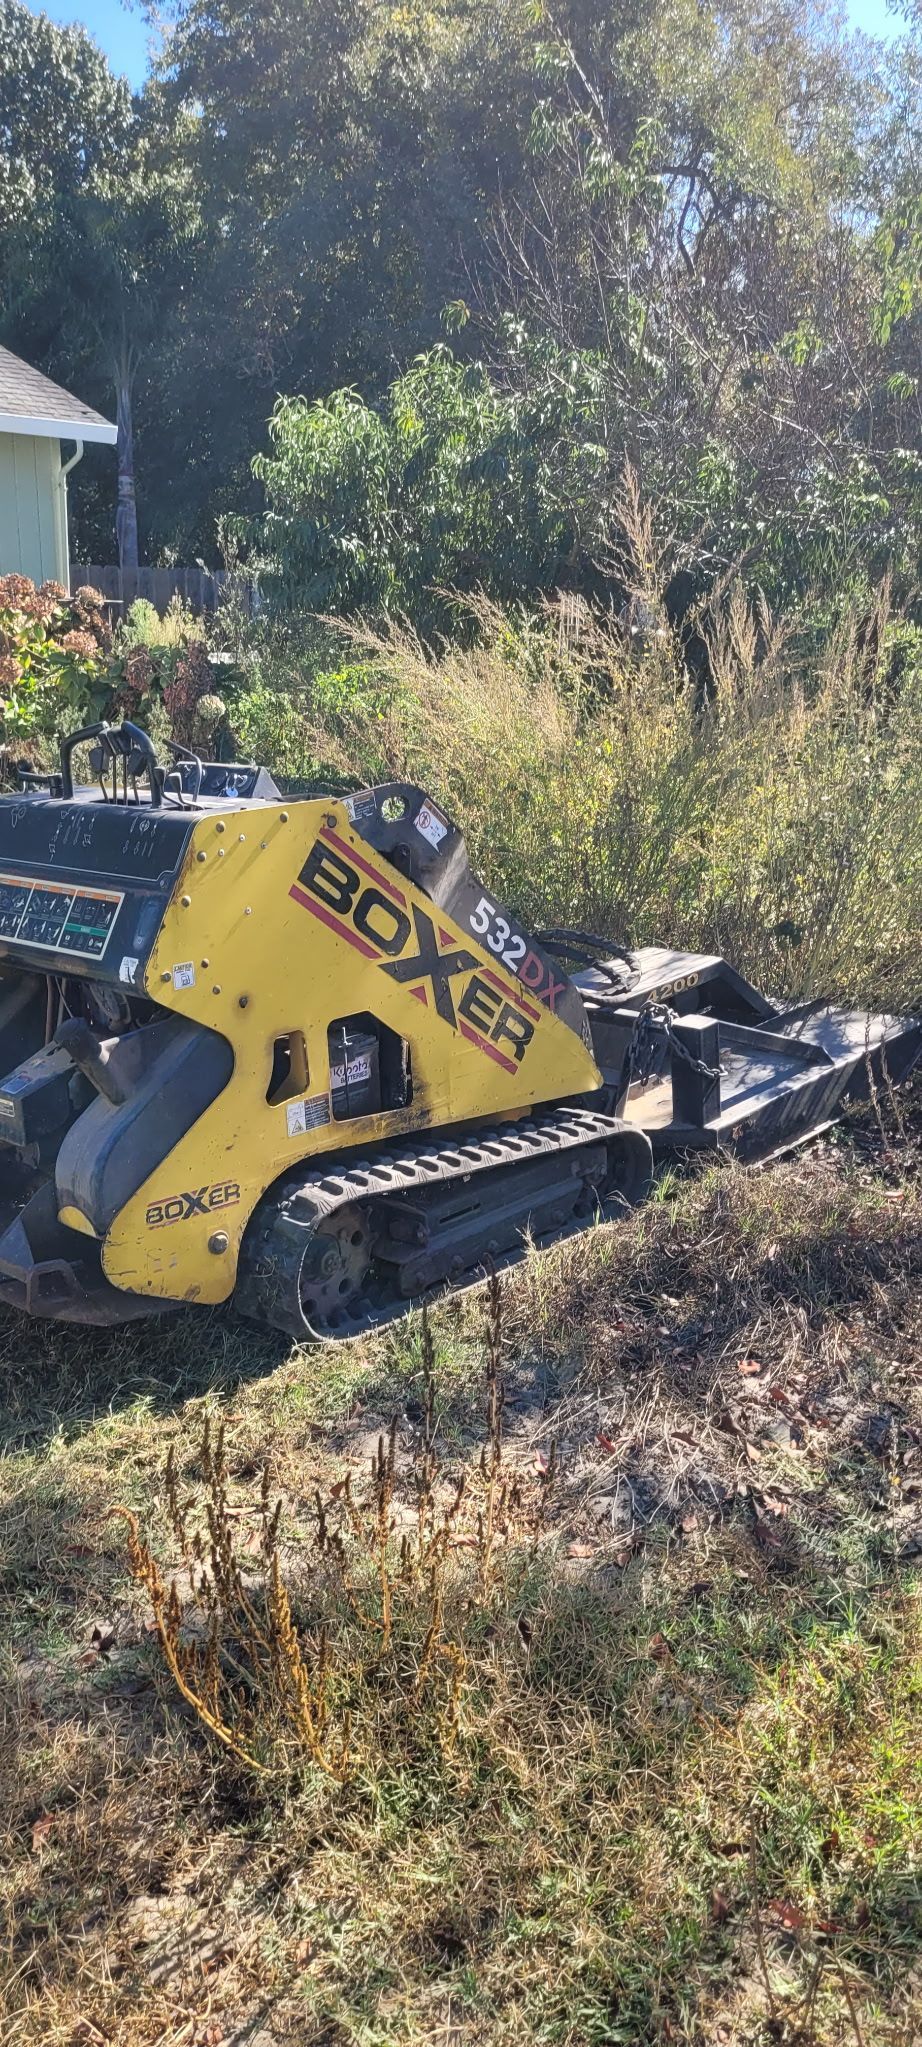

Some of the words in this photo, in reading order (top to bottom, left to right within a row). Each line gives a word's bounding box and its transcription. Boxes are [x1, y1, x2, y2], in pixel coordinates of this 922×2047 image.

[297, 839, 535, 1062] BOXER
[470, 897, 566, 1011] 532DX
[647, 972, 699, 1003] 4200
[340, 1070, 369, 1084] BTTERIES
[146, 1184, 241, 1225] BOXER
